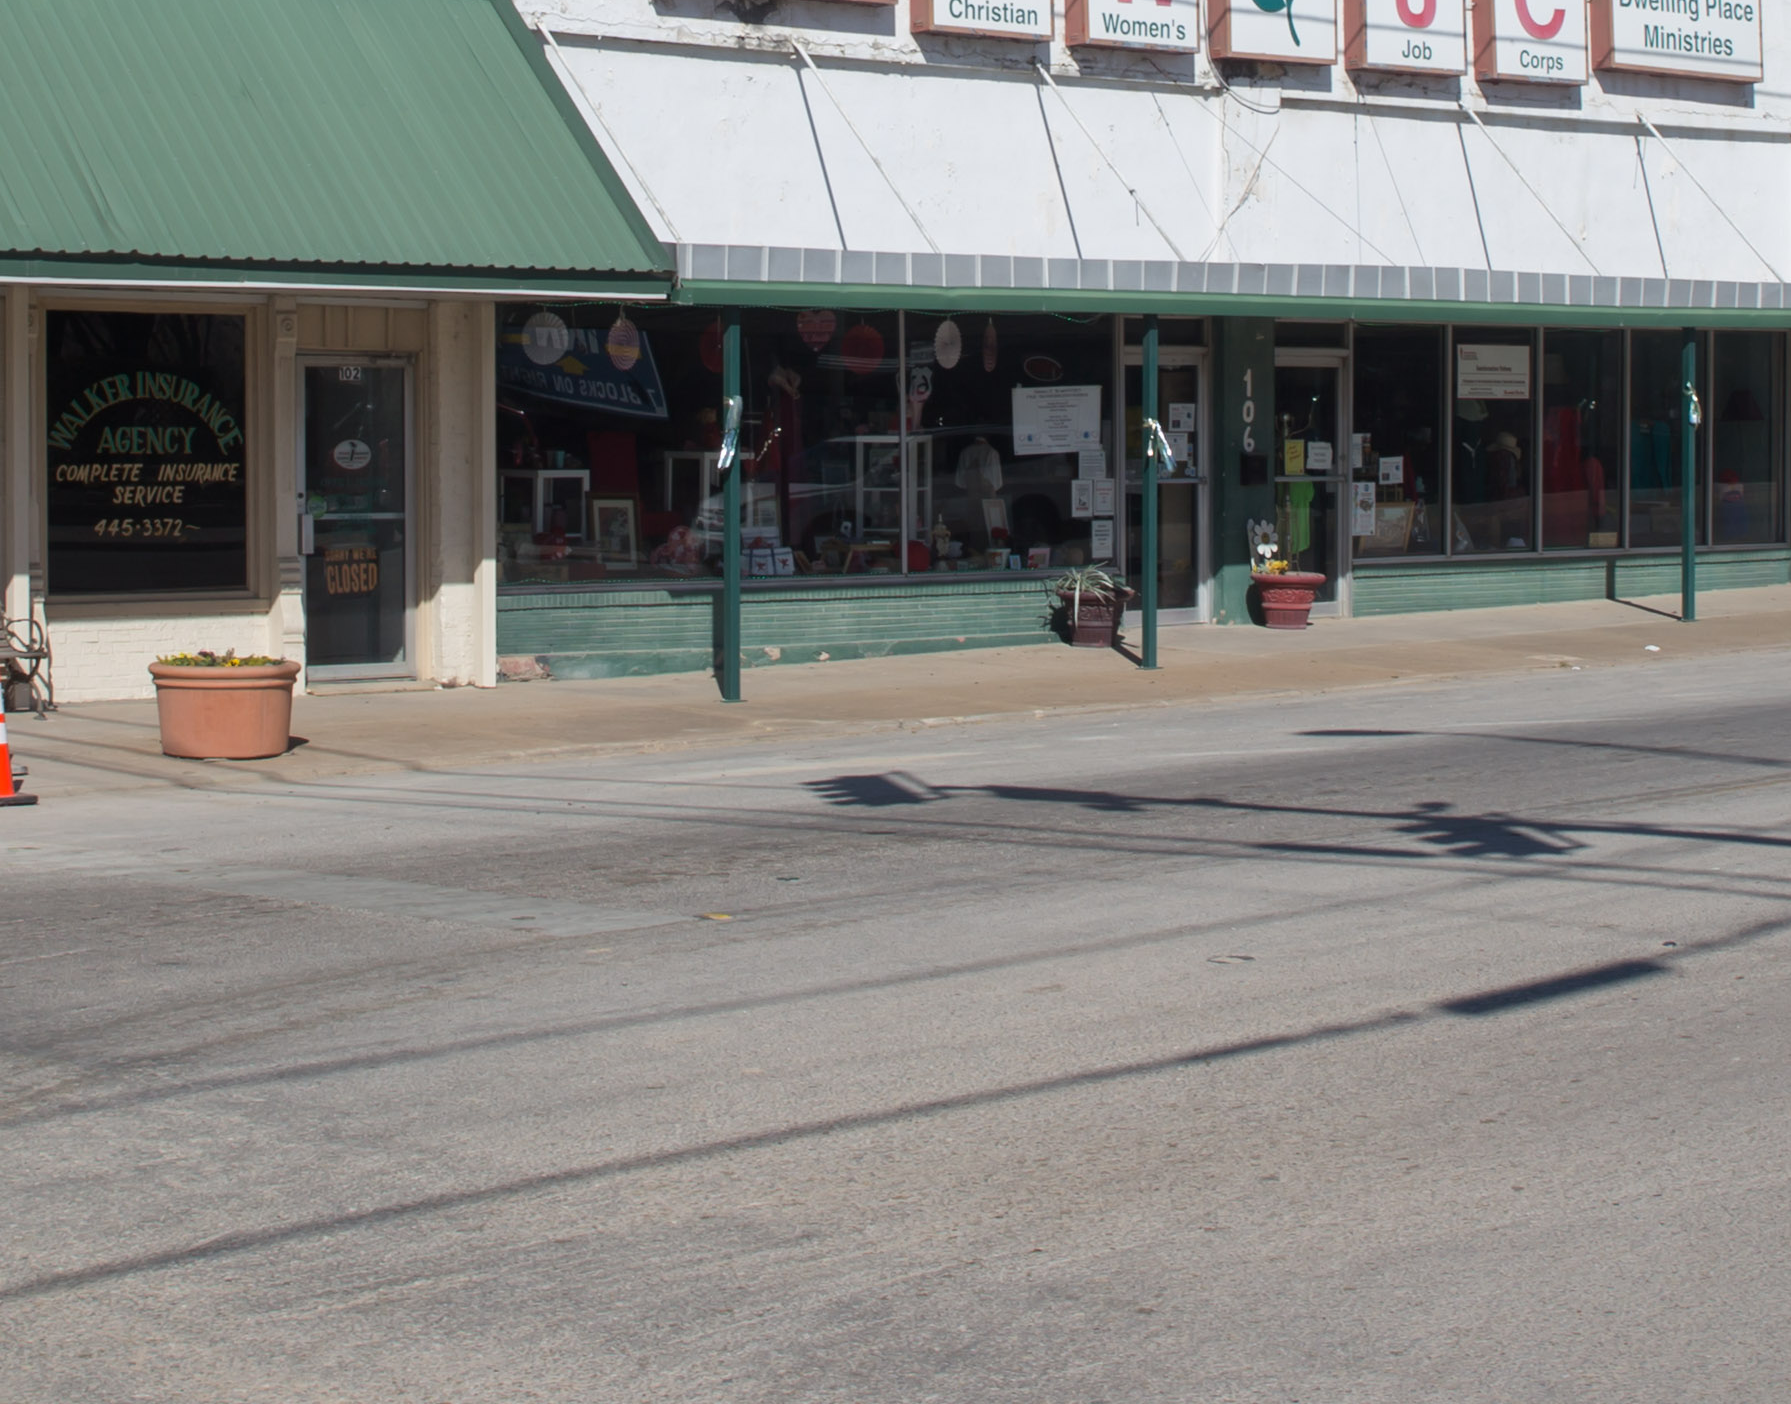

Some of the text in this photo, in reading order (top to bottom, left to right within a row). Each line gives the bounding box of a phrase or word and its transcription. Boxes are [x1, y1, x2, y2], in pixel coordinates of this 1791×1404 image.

[1102, 12, 1186, 40] Women's
[1643, 24, 1733, 56] Ministries
[1401, 39, 1432, 61] Job
[1519, 49, 1564, 74] Corps
[339, 367, 360, 380] 102
[48, 371, 244, 456] WALKER INSURANCE
[1242, 368, 1256, 453] 106
[96, 427, 197, 455] AGENCY
[56, 463, 240, 484] COMPLETE INSURANCE
[112, 486, 185, 507] SERVICE
[327, 563, 378, 595] CLOSED
